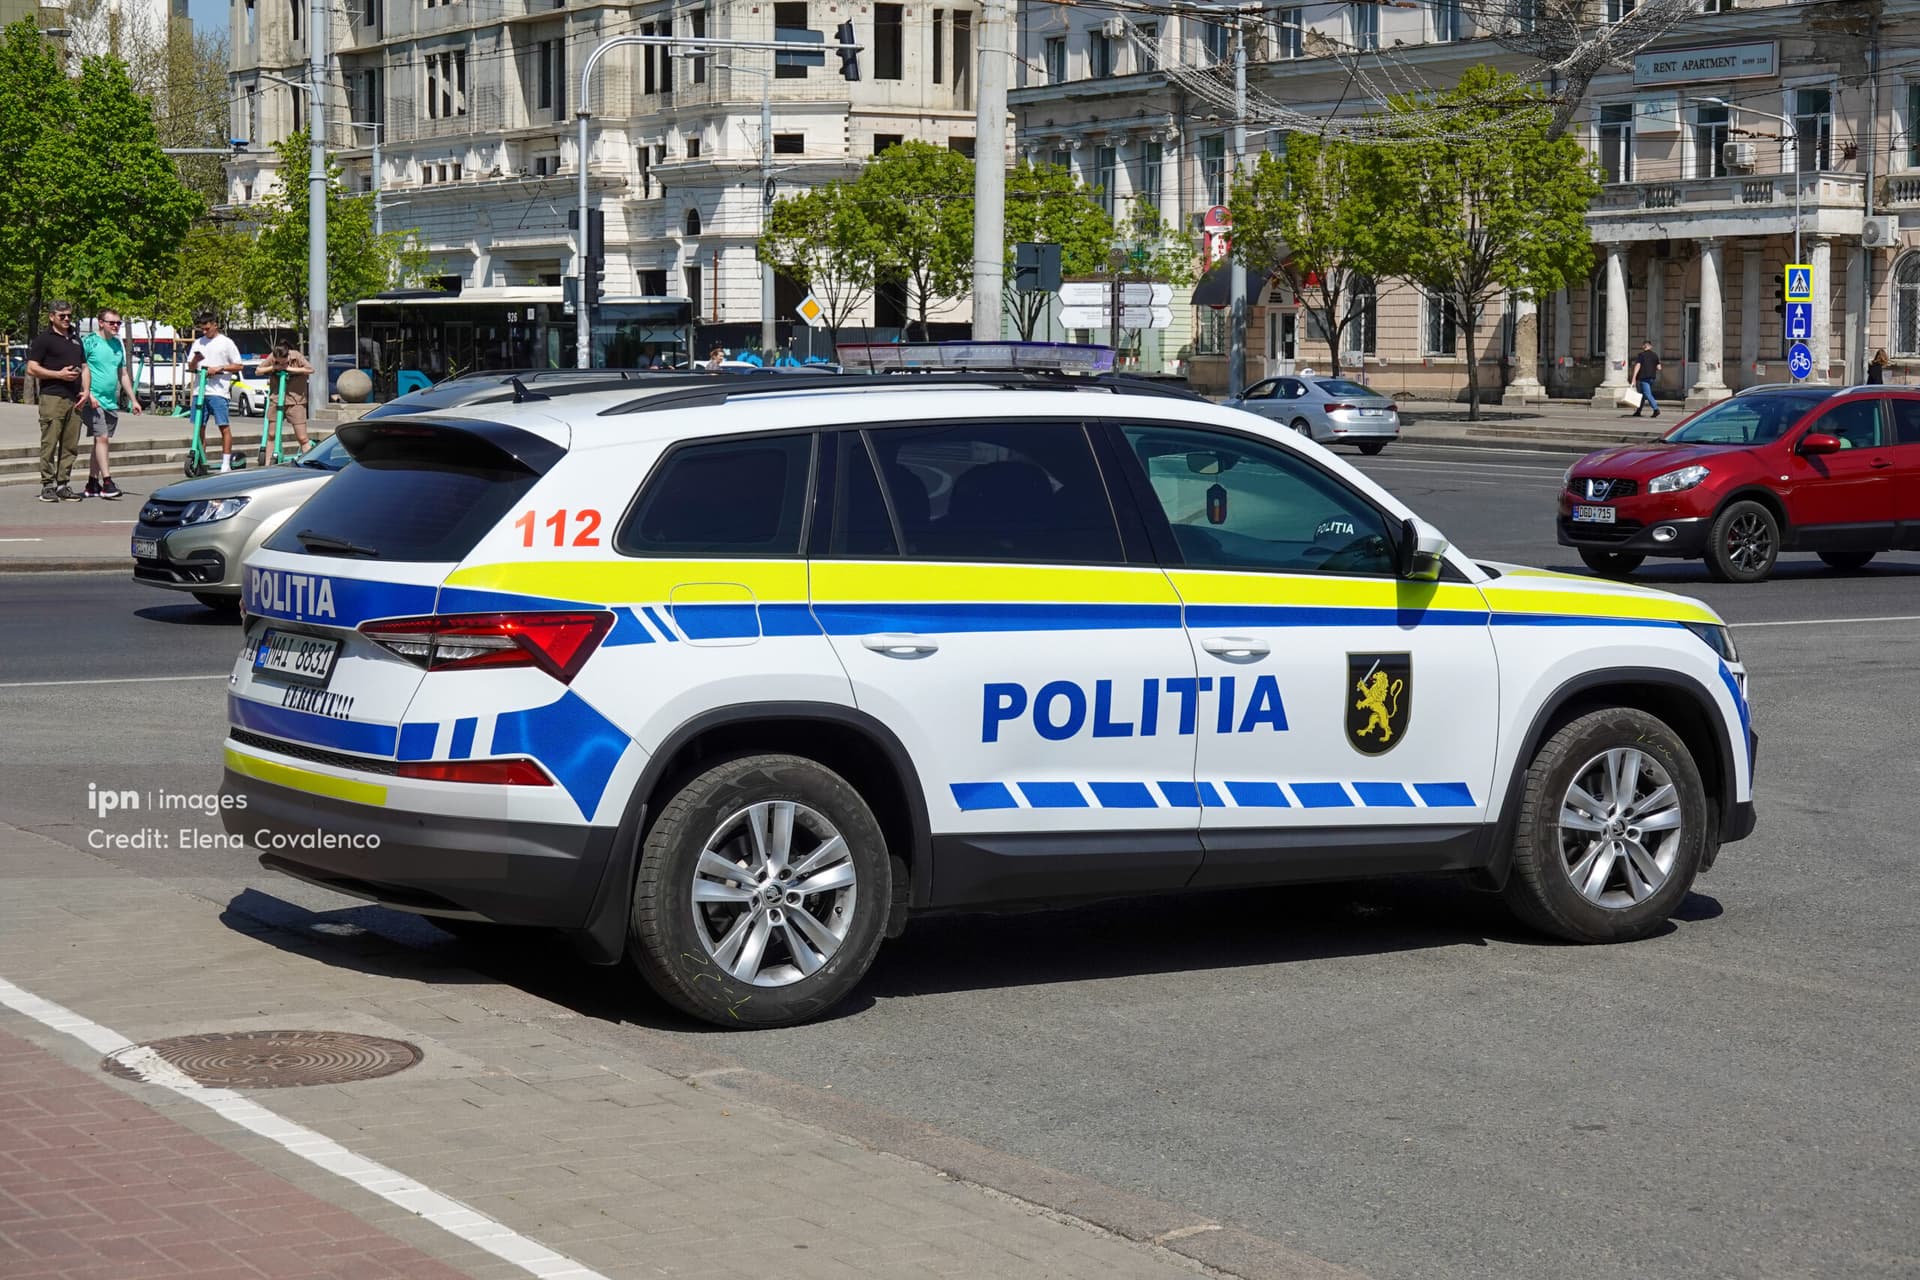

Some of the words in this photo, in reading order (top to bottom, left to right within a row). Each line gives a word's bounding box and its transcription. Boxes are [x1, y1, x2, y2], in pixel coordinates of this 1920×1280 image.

[1653, 61, 1678, 73] RENT
[1682, 56, 1737, 71] APARTMENT
[515, 509, 602, 547] 112
[1598, 508, 1612, 519] 715
[251, 569, 336, 621] POLIȚIA
[266, 635, 295, 668] MAI
[295, 640, 333, 676] 8831
[981, 675, 1289, 743] POLITIA
